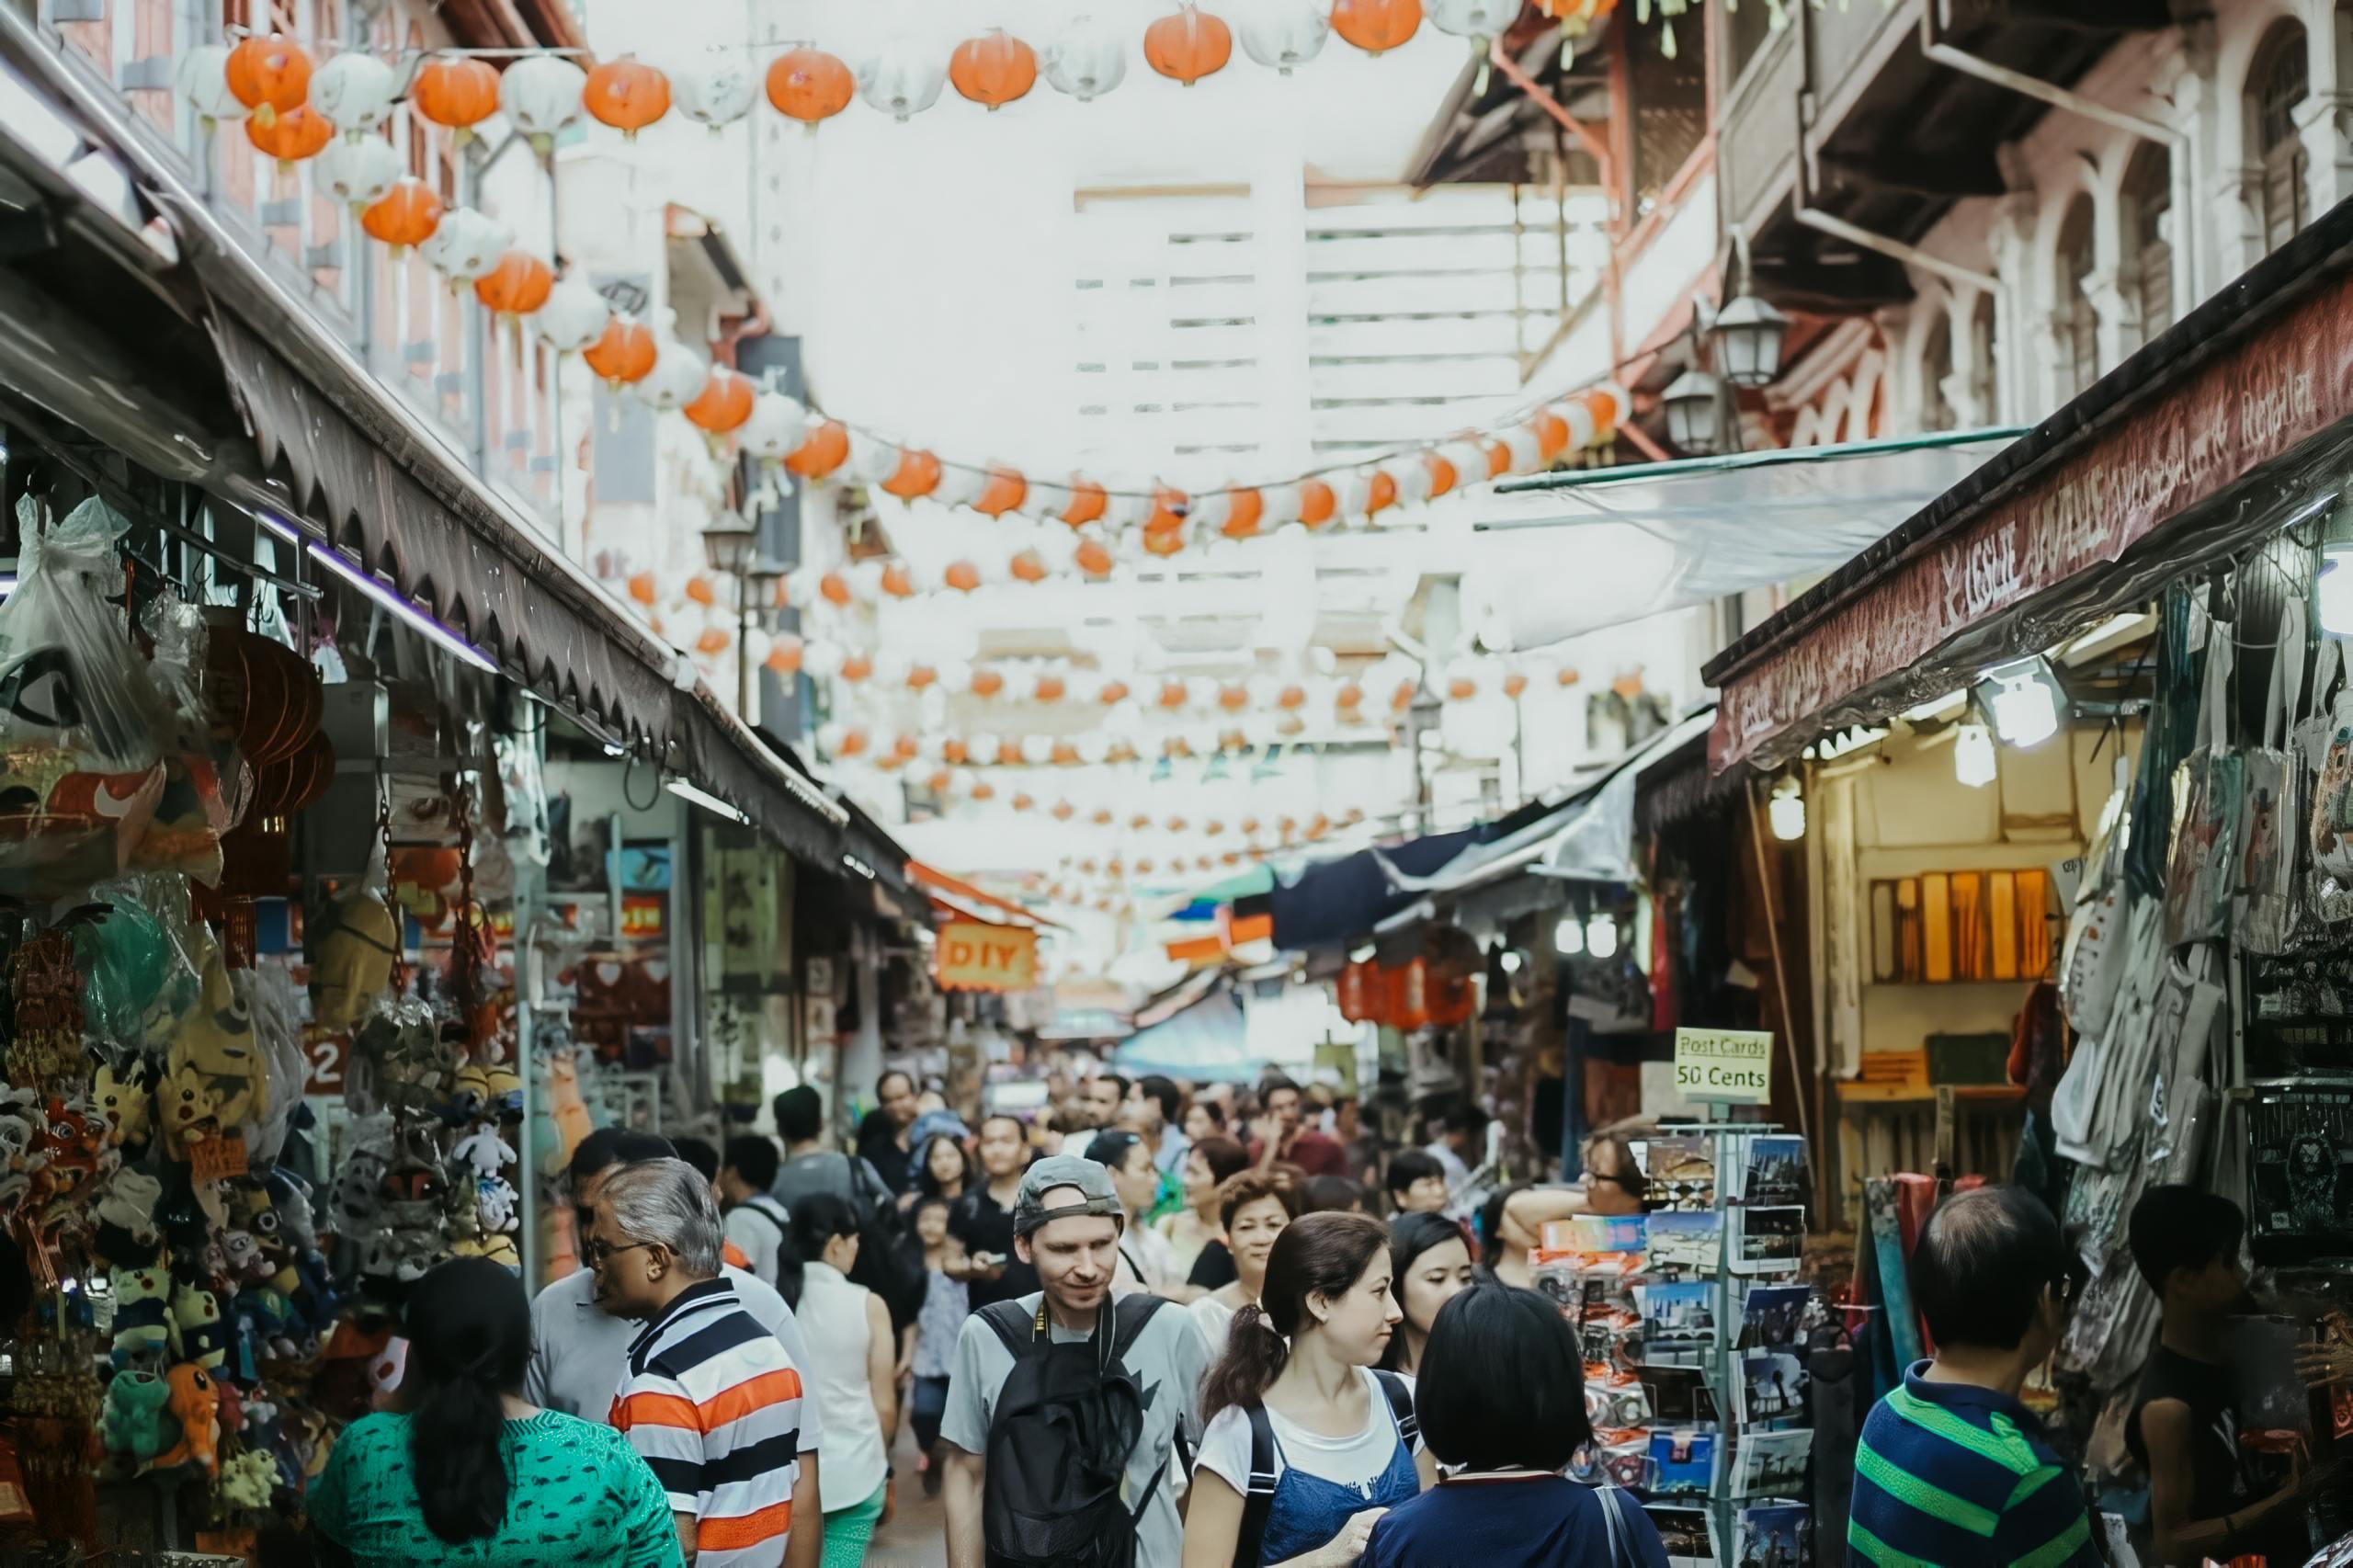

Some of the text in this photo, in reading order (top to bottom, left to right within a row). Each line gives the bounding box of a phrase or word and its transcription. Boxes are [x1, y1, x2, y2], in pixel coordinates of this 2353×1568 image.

[949, 940, 1017, 971] DIY
[1679, 1037, 1766, 1056] Post Cards
[1677, 1065, 1766, 1087] 50 Cents
